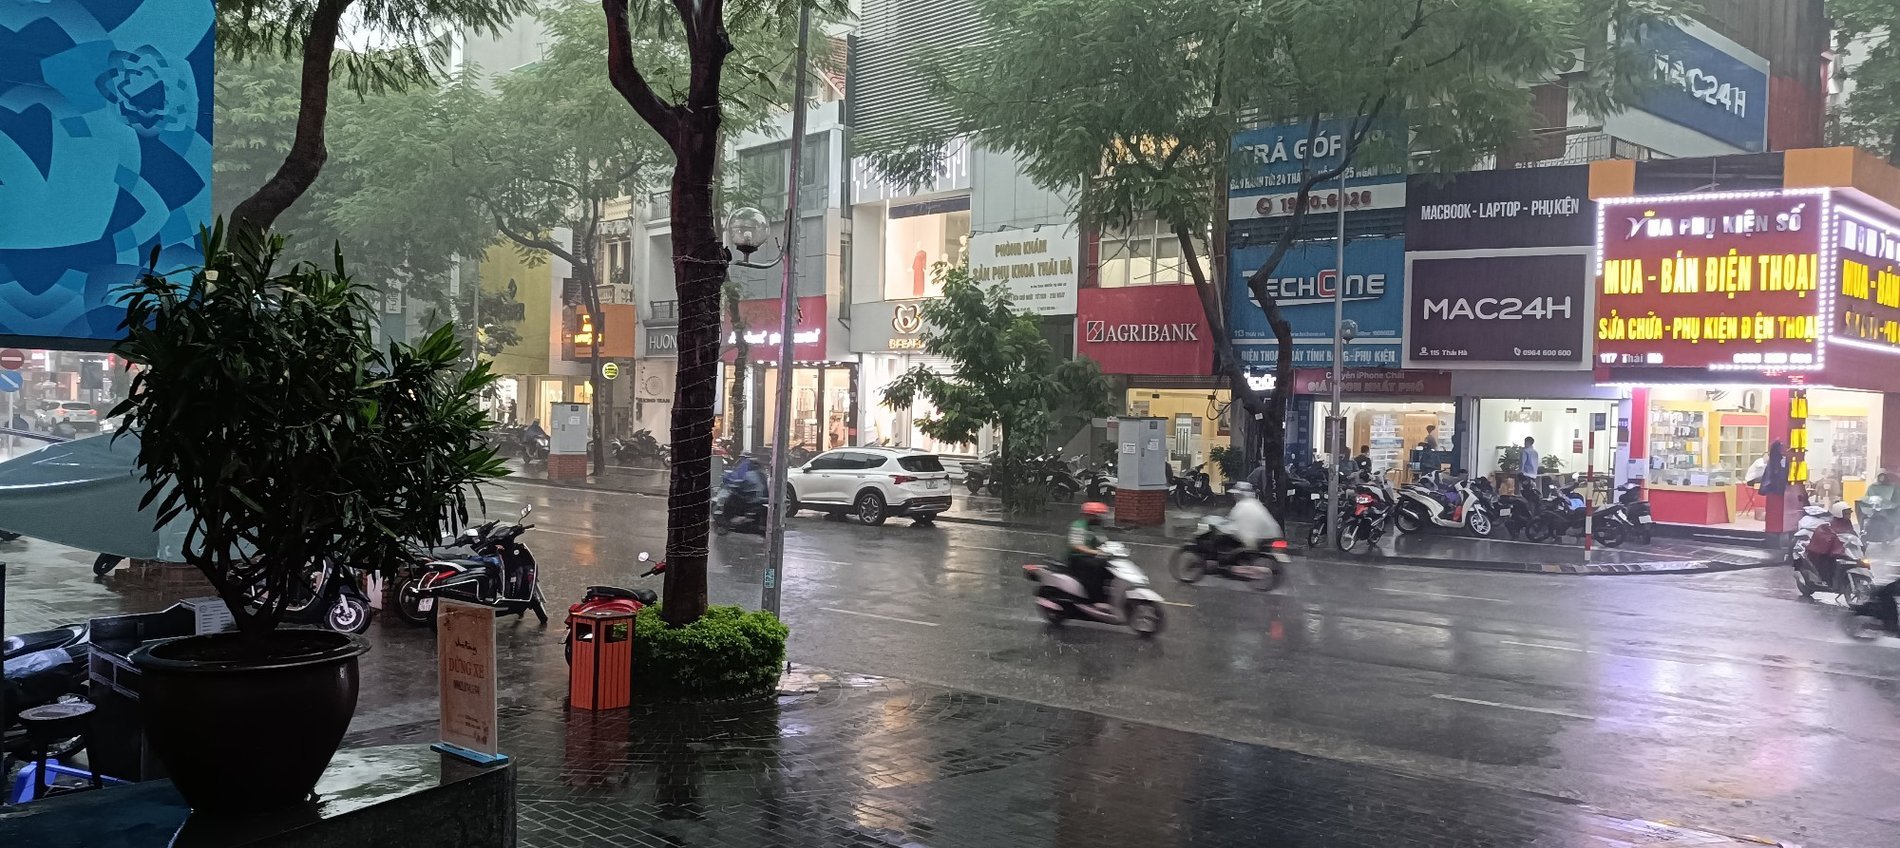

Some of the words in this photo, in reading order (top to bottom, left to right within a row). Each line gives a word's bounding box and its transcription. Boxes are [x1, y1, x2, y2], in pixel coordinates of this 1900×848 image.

[1276, 174, 1286, 185] 24
[1345, 166, 1354, 178] 25
[1421, 204, 1471, 220] MACBOOK
[1479, 201, 1520, 218] LAPTOP
[1531, 199, 1554, 217] PHỤ
[1554, 196, 1579, 216] KIỆN
[1723, 209, 1768, 237] KIỆN
[1776, 203, 1805, 232] SỐ
[1024, 238, 1048, 254] KHÁM
[992, 266, 1010, 281] PHỤ
[1012, 262, 1036, 278] KHOA
[1037, 258, 1058, 276] THÁI
[1060, 256, 1074, 275] HÀ
[1604, 259, 1643, 294] MUA
[1660, 250, 1699, 293] BÁN
[1705, 248, 1752, 299] ĐIỆN
[1758, 253, 1817, 298] THOẠI
[1842, 259, 1868, 300] MUA
[1423, 296, 1571, 320] MAC24H
[1106, 324, 1198, 342] AGRIBANK
[1598, 309, 1625, 340] SỬA
[1628, 311, 1663, 340] CHỮA
[1672, 318, 1700, 344] PHỤ
[1704, 312, 1738, 344] KIỆN
[1374, 348, 1395, 364] KIỆN
[1622, 354, 1644, 362] Thái
